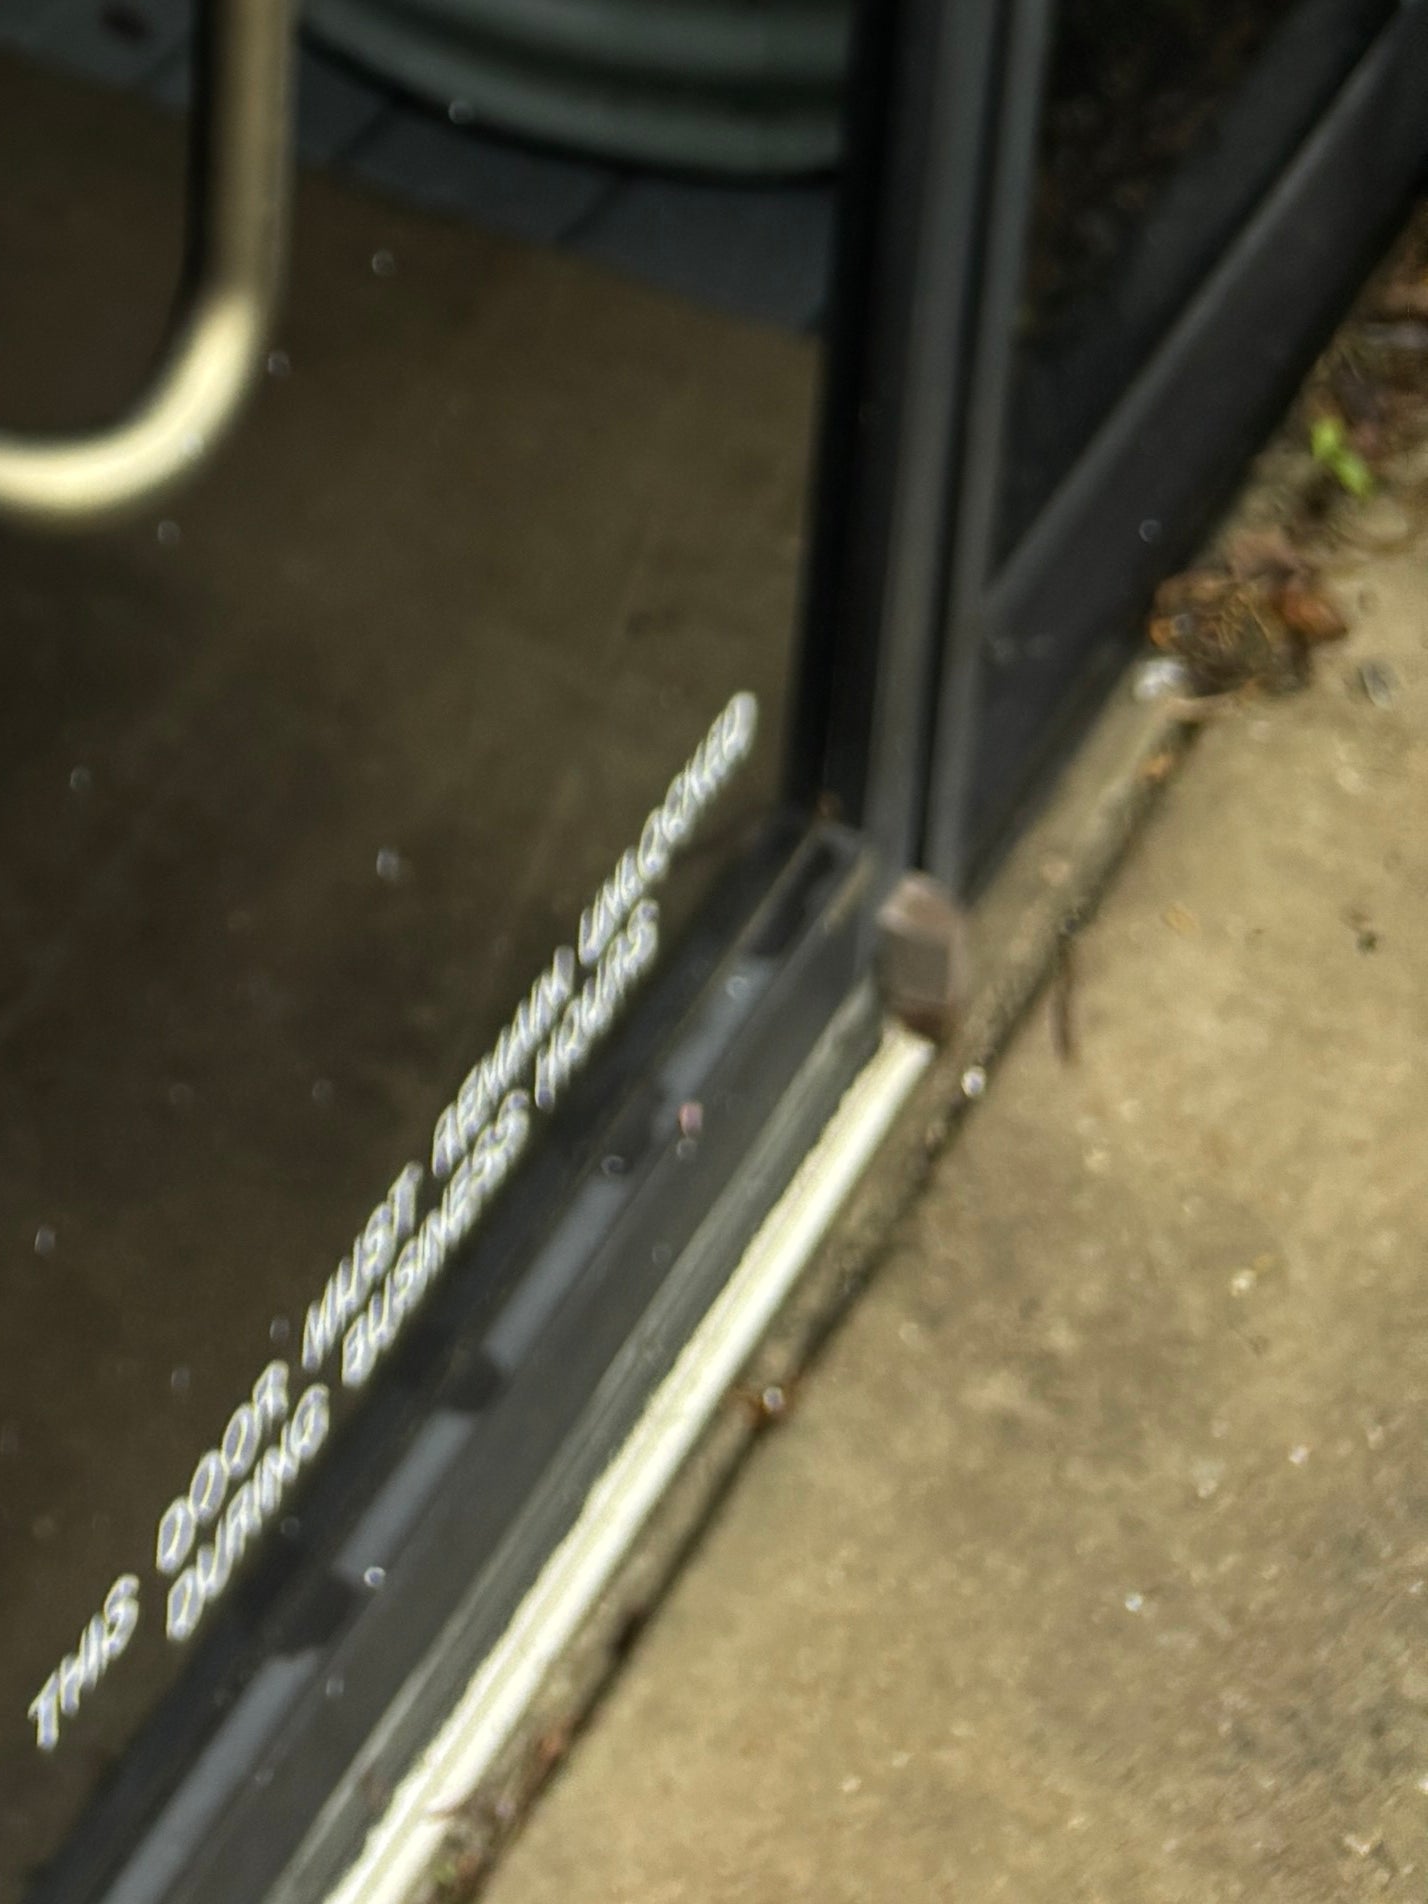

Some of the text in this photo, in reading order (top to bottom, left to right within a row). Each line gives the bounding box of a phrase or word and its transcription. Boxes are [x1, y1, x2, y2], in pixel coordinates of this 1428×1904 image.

[27, 689, 759, 1752] THIS DOOR MUST REMAIN UNLOCKED
[165, 897, 661, 1644] DURING BUSINESS HOURS
